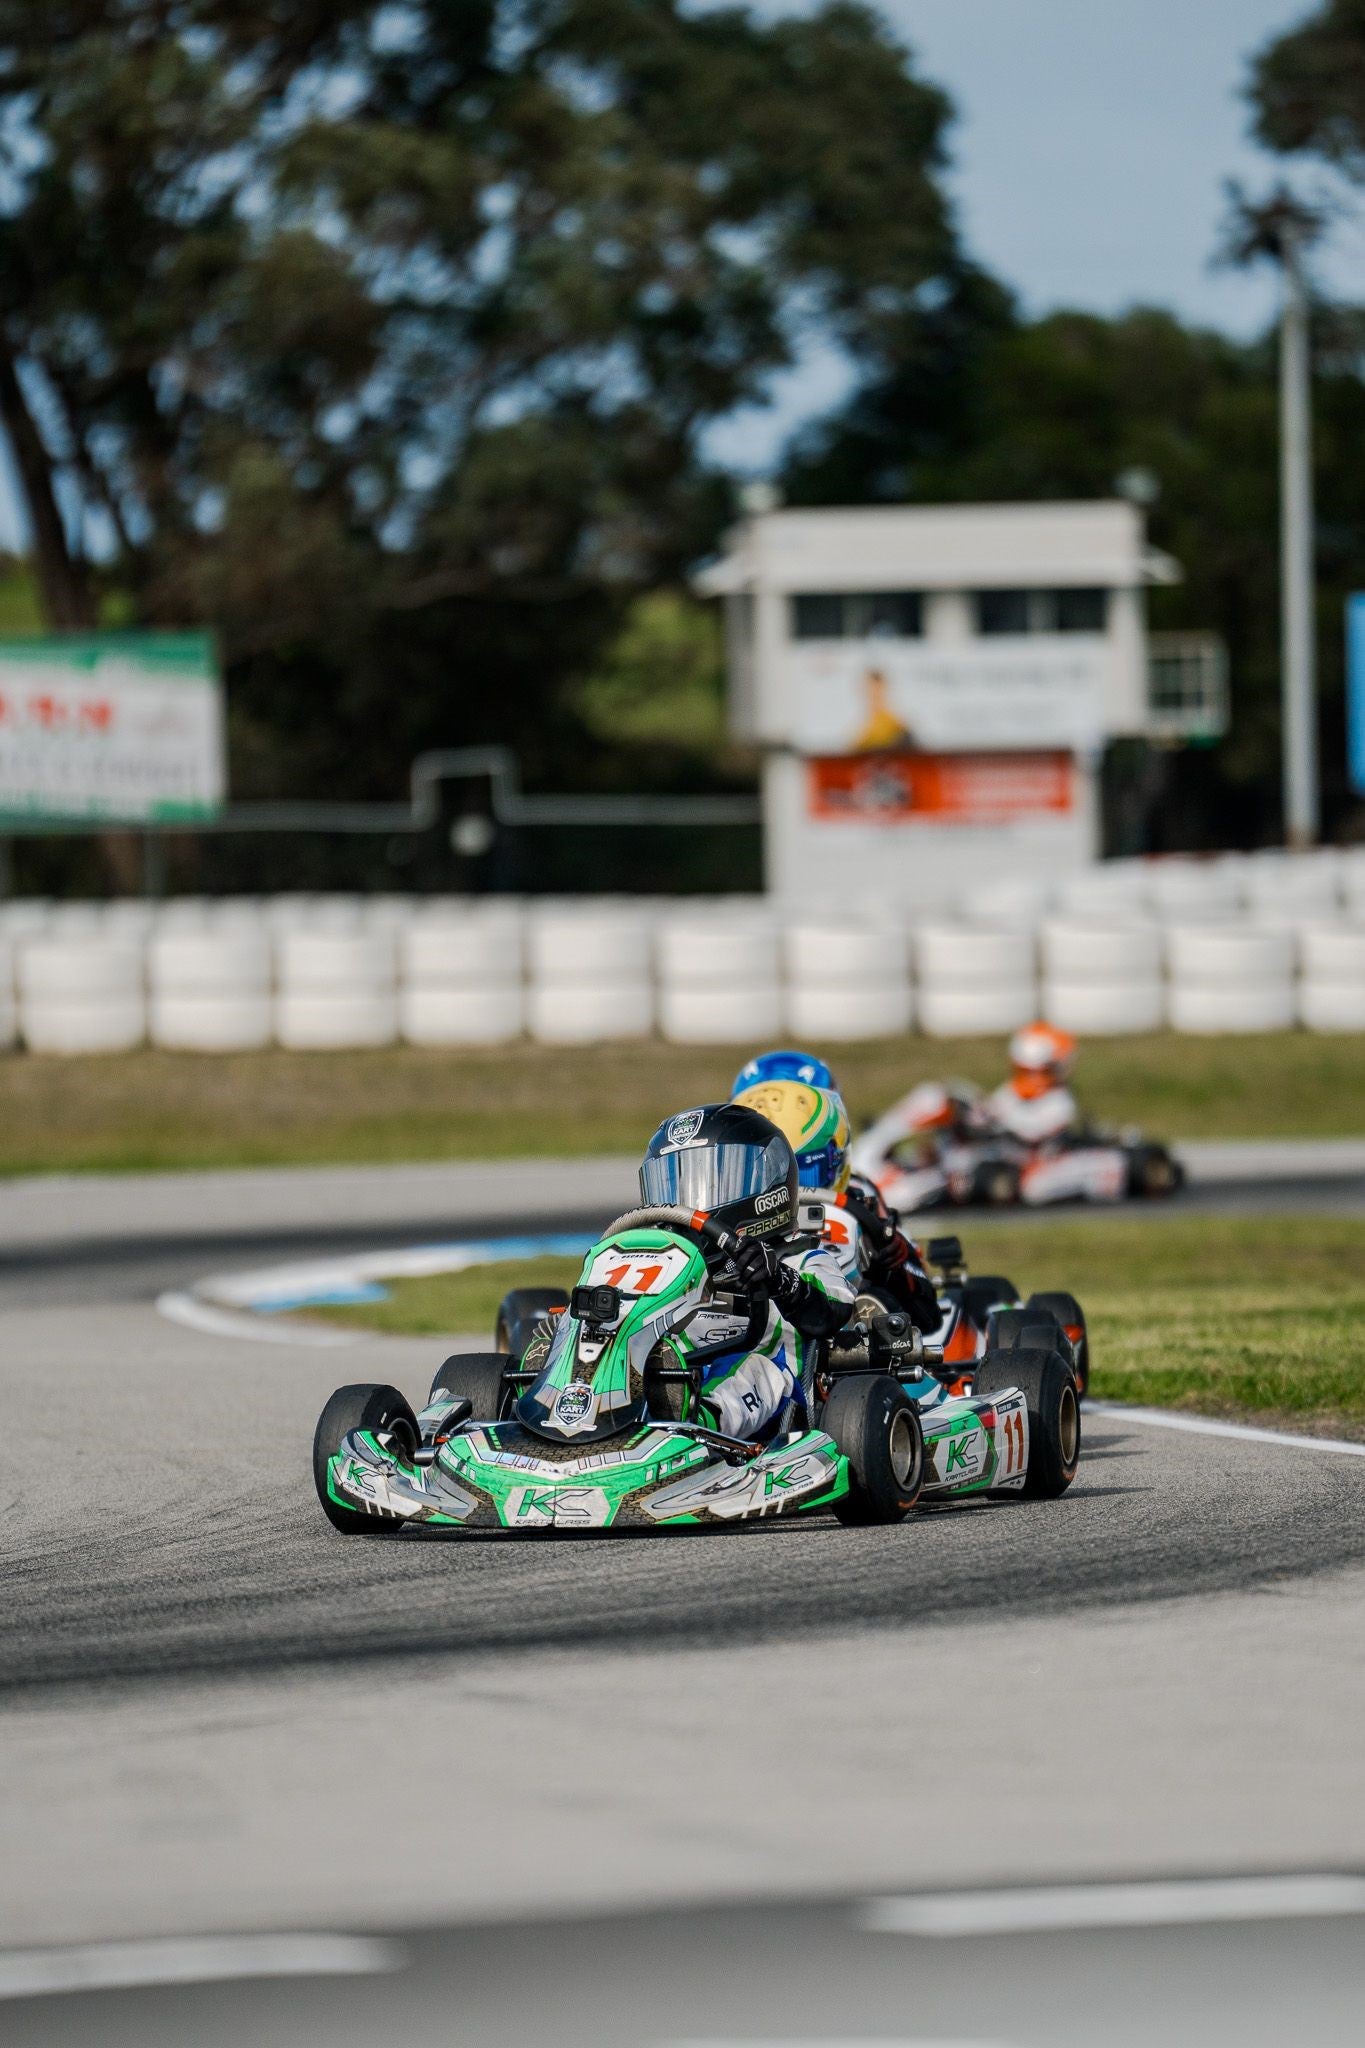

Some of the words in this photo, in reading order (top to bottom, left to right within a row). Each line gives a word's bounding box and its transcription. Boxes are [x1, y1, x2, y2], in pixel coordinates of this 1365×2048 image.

[757, 1189, 788, 1213] OSCAR
[604, 1264, 663, 1292] 11
[560, 1405, 585, 1414] KART
[1004, 1411, 1024, 1474] 11
[945, 1467, 979, 1482] KARTCLASS
